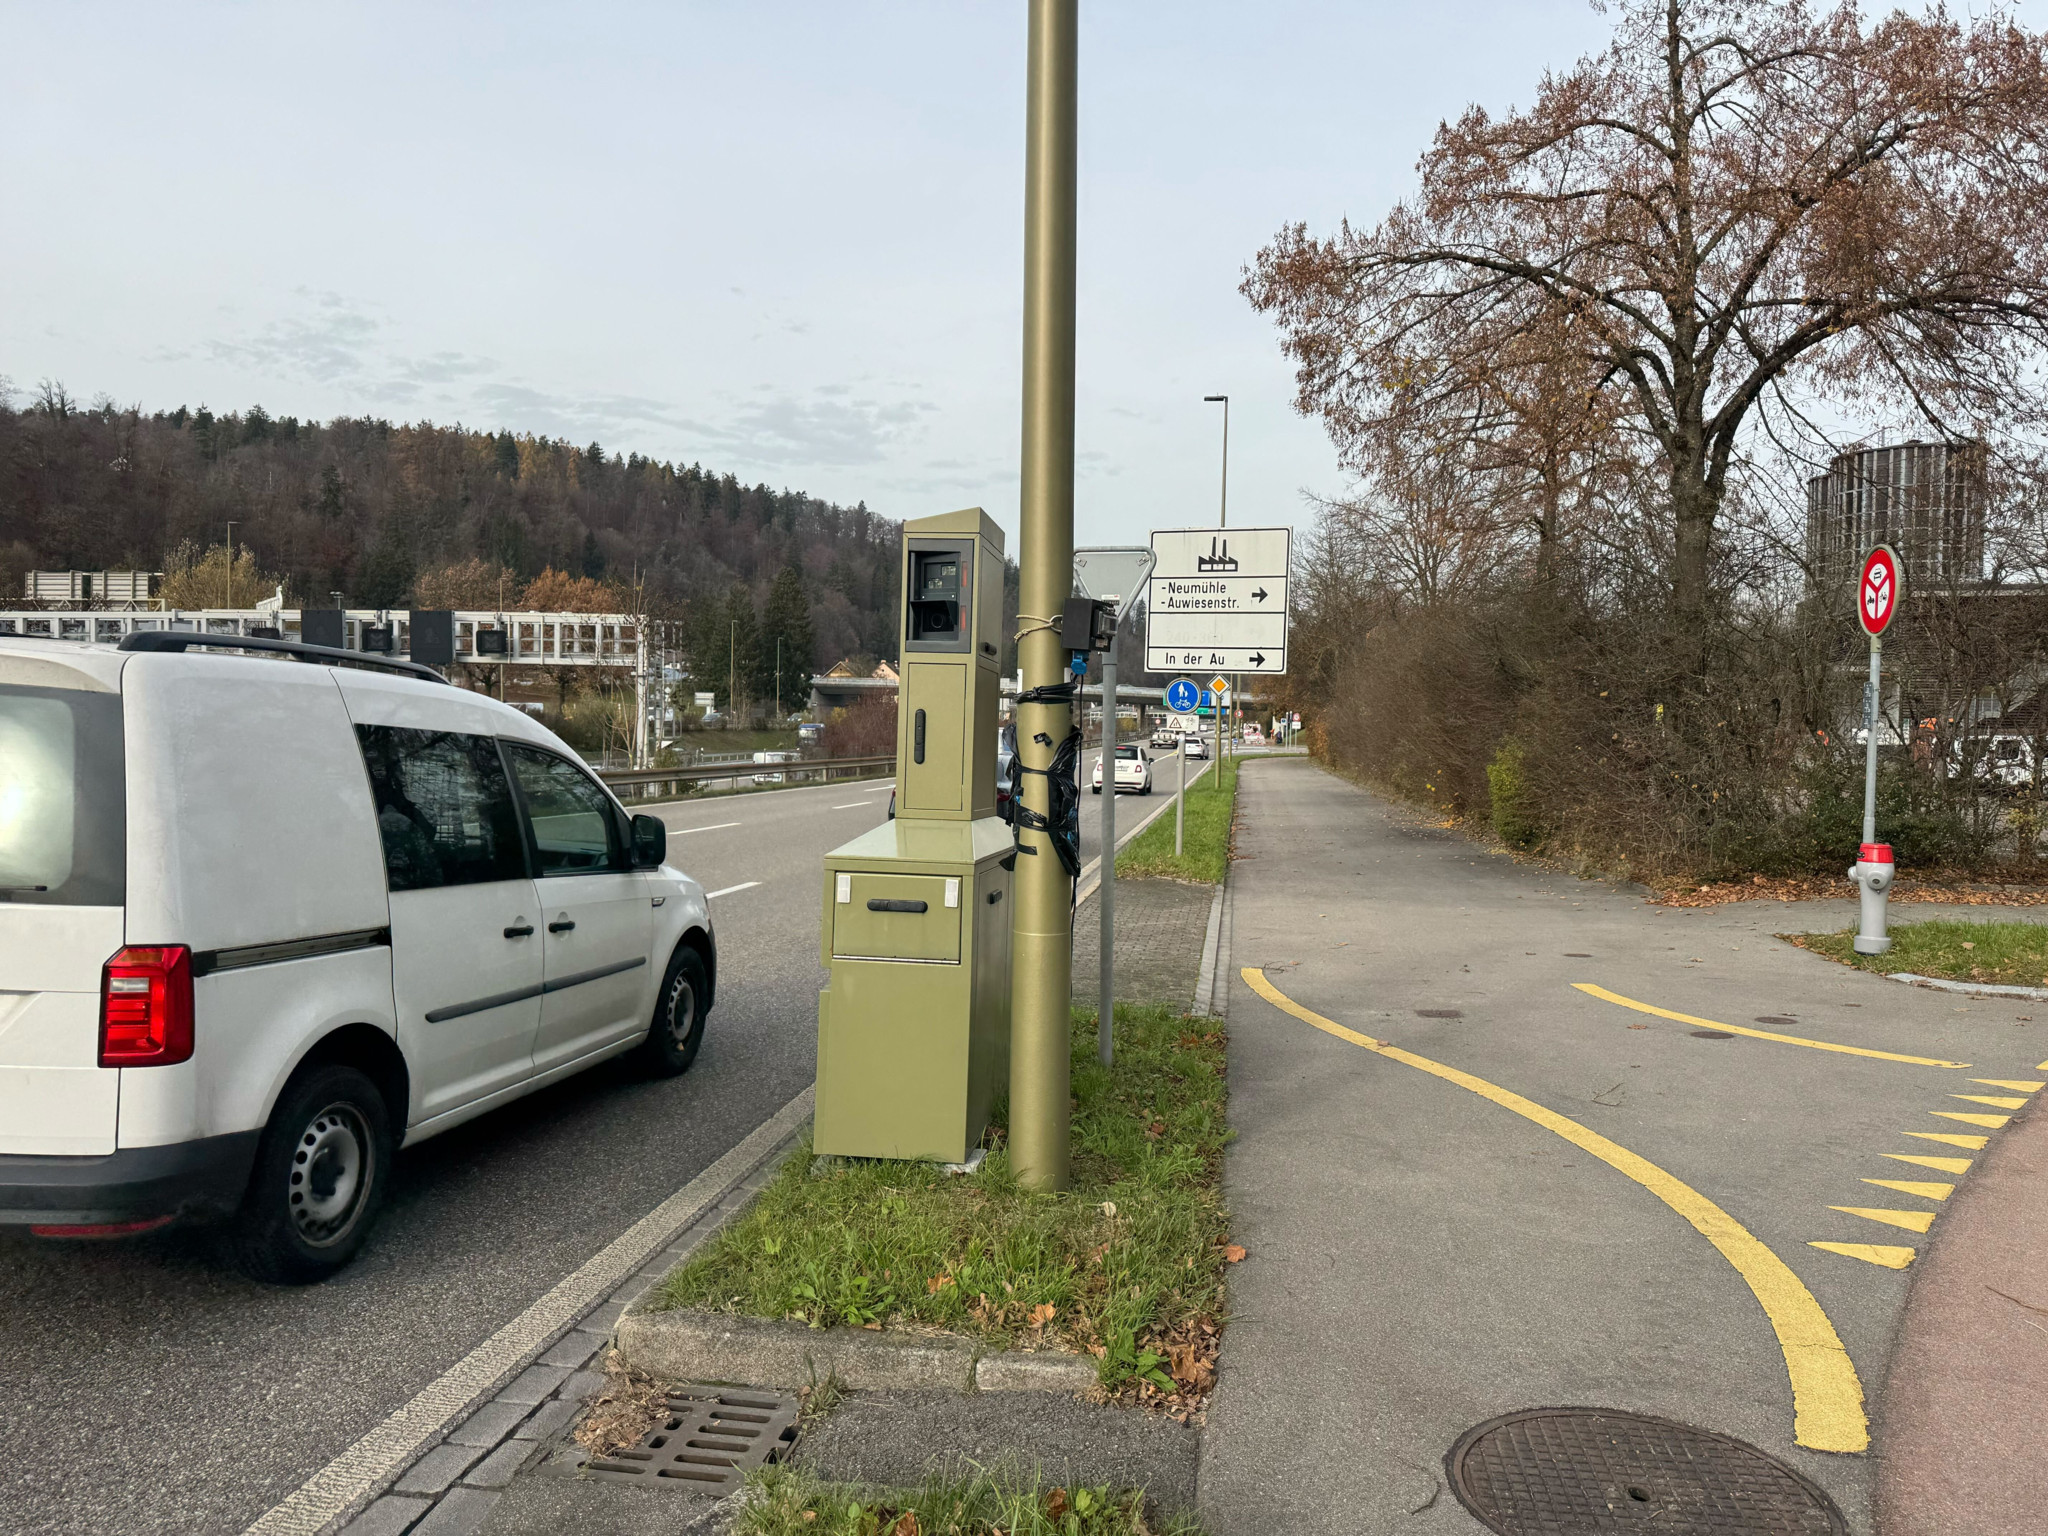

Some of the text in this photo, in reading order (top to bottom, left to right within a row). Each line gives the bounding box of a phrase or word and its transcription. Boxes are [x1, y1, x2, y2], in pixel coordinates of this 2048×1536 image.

[1165, 652, 1225, 665] In der Au
